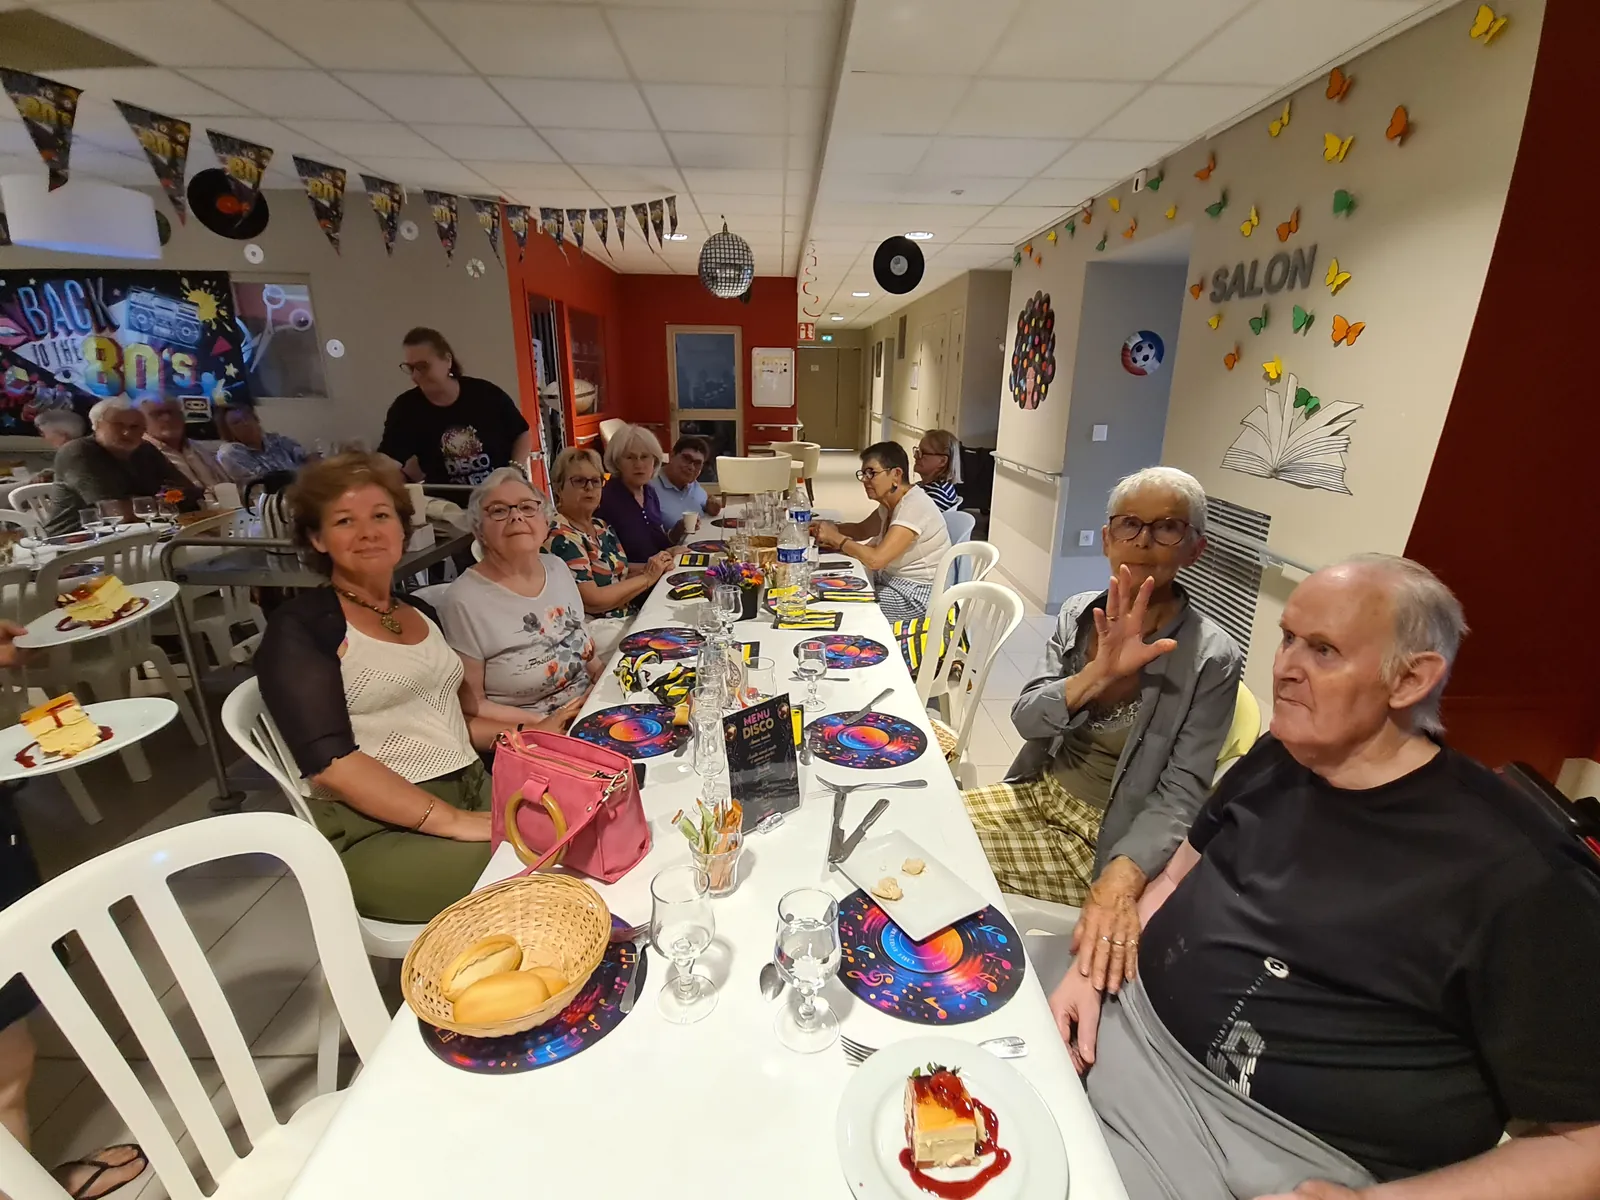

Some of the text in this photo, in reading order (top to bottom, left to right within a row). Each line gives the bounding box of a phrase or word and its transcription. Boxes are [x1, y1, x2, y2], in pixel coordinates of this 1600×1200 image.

[1209, 243, 1318, 303] SALON
[17, 276, 120, 336] BACK
[31, 337, 83, 367] TO THE
[82, 336, 197, 400] 80's
[742, 717, 775, 740] DISCO
[743, 708, 770, 726] MENU
